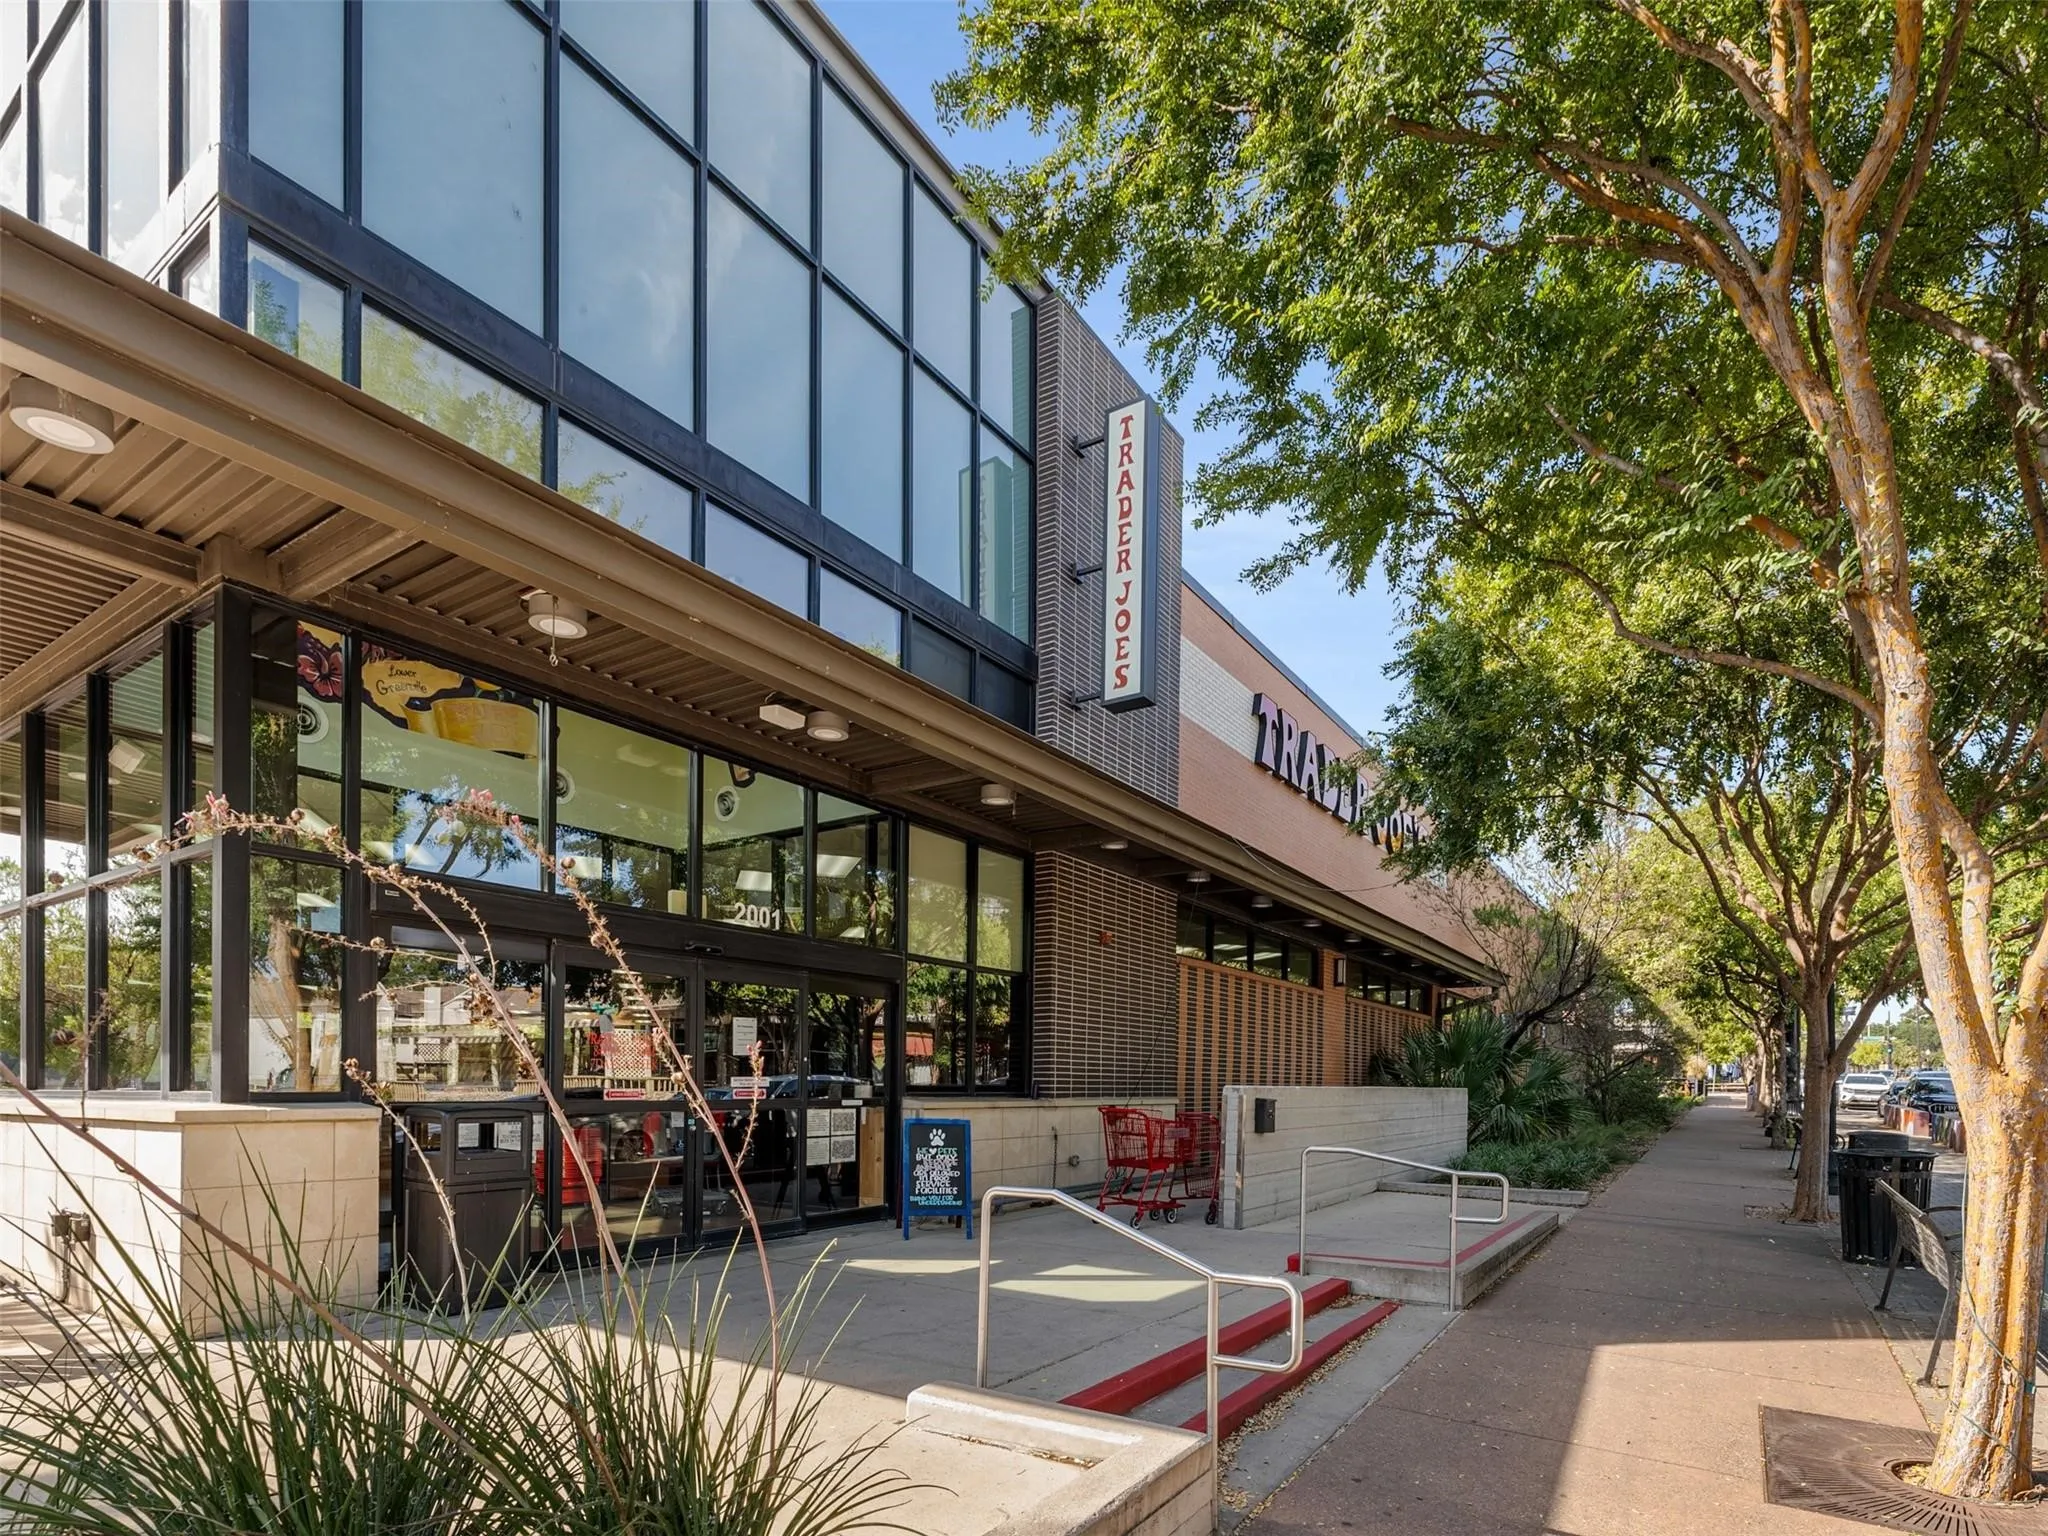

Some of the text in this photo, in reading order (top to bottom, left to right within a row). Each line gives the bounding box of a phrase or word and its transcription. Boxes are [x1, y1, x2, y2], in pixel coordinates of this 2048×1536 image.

[1113, 414, 1136, 690] TRADER JOES
[387, 664, 418, 678] Lower
[734, 901, 781, 931] 2001
